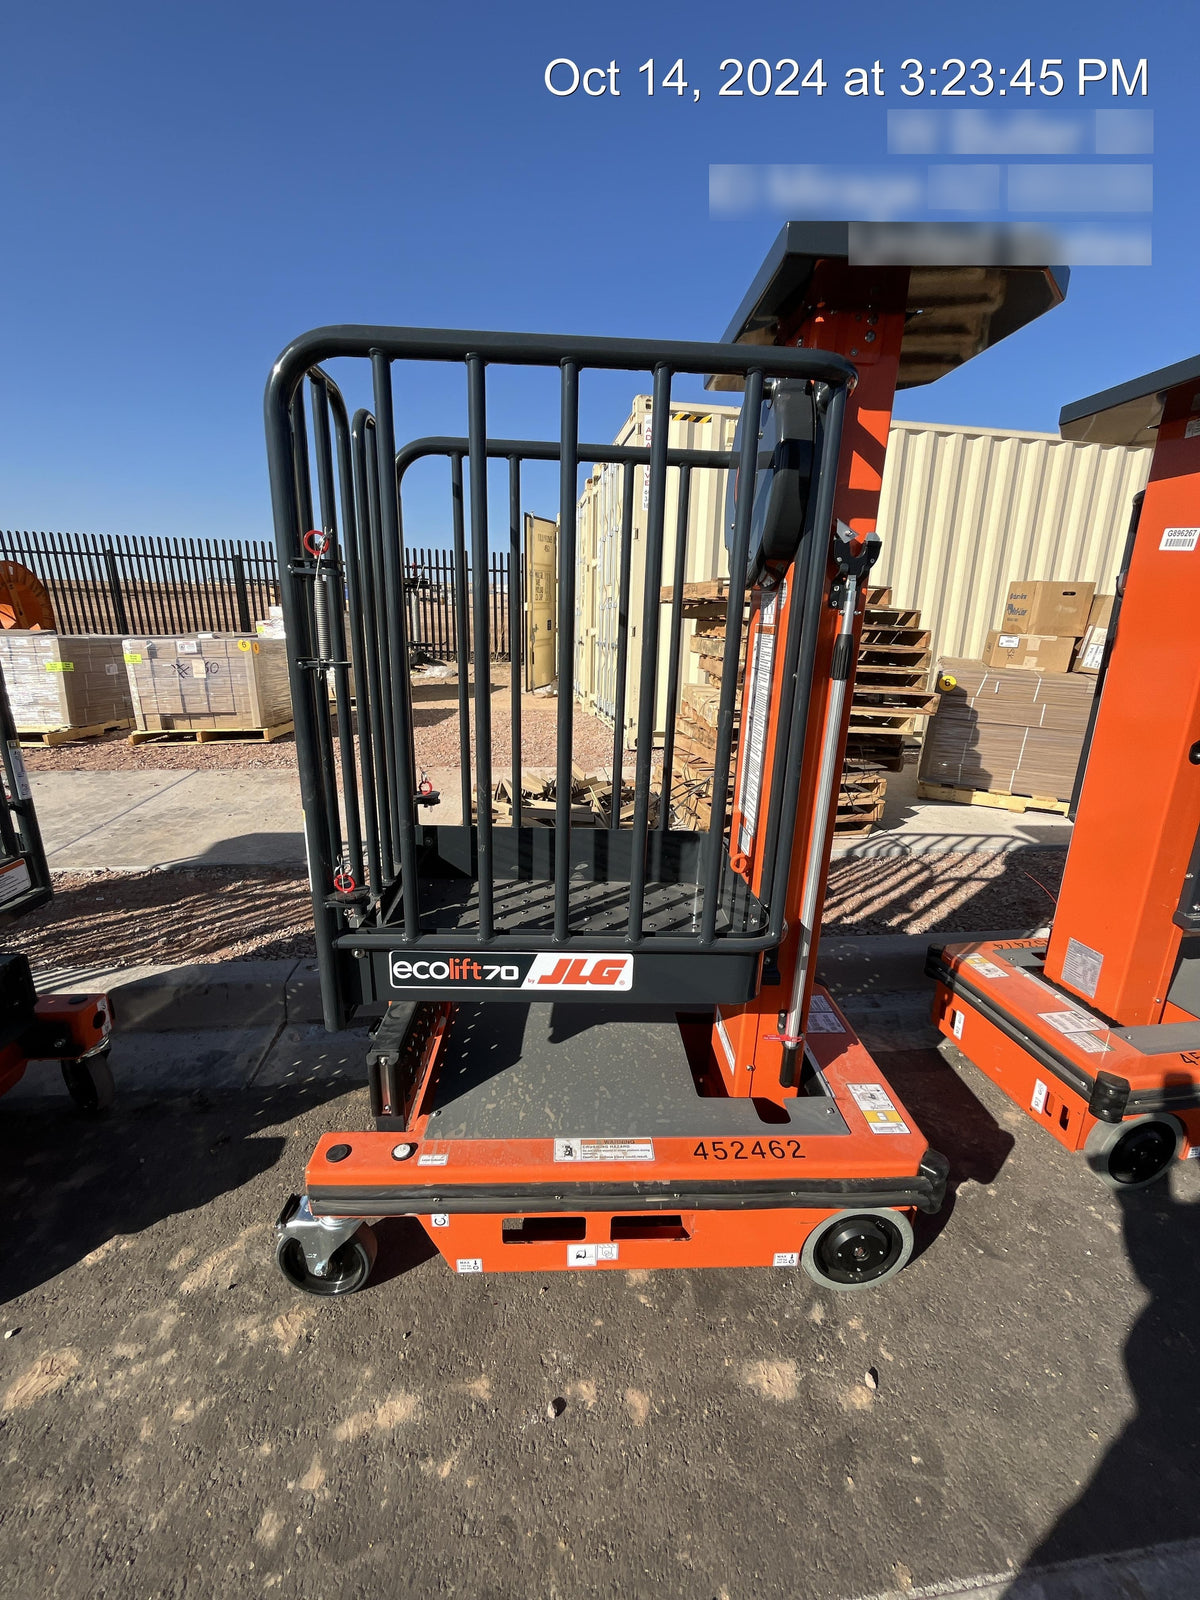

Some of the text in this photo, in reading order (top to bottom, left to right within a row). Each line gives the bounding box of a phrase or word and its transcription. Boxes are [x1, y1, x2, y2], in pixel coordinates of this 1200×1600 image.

[1167, 529, 1198, 537] G896267
[944, 678, 951, 687] 6
[537, 958, 628, 985] JLG
[693, 1139, 806, 1160] 452462
